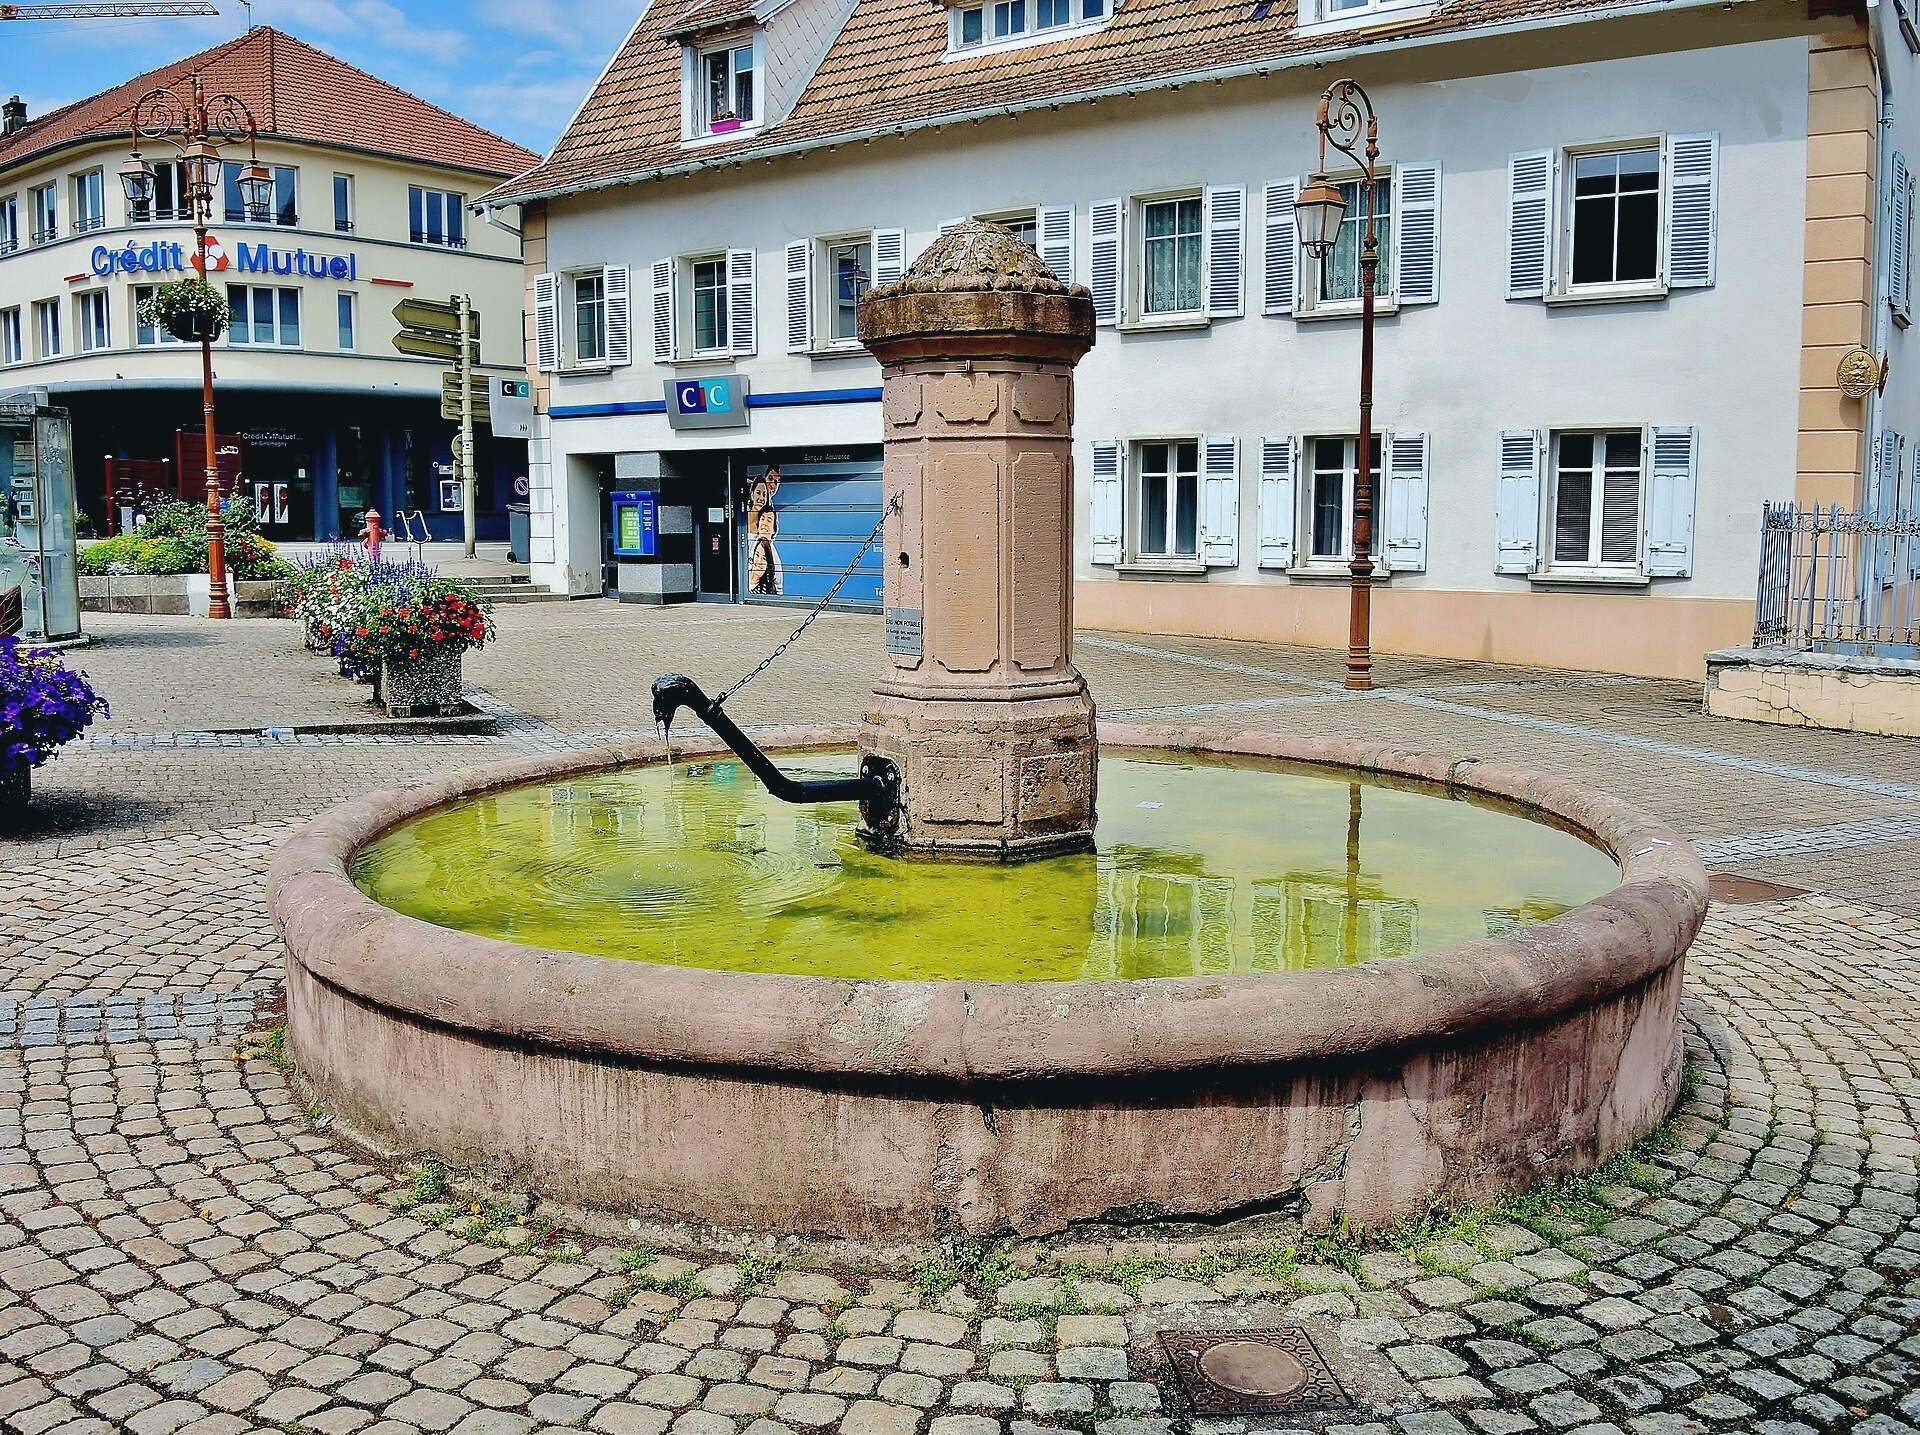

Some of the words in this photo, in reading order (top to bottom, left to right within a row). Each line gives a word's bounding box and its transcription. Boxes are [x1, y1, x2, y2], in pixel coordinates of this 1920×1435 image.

[91, 239, 184, 276] Crédit
[236, 242, 357, 281] Mutuel
[504, 384, 526, 395] CIC
[682, 386, 725, 408] CIC
